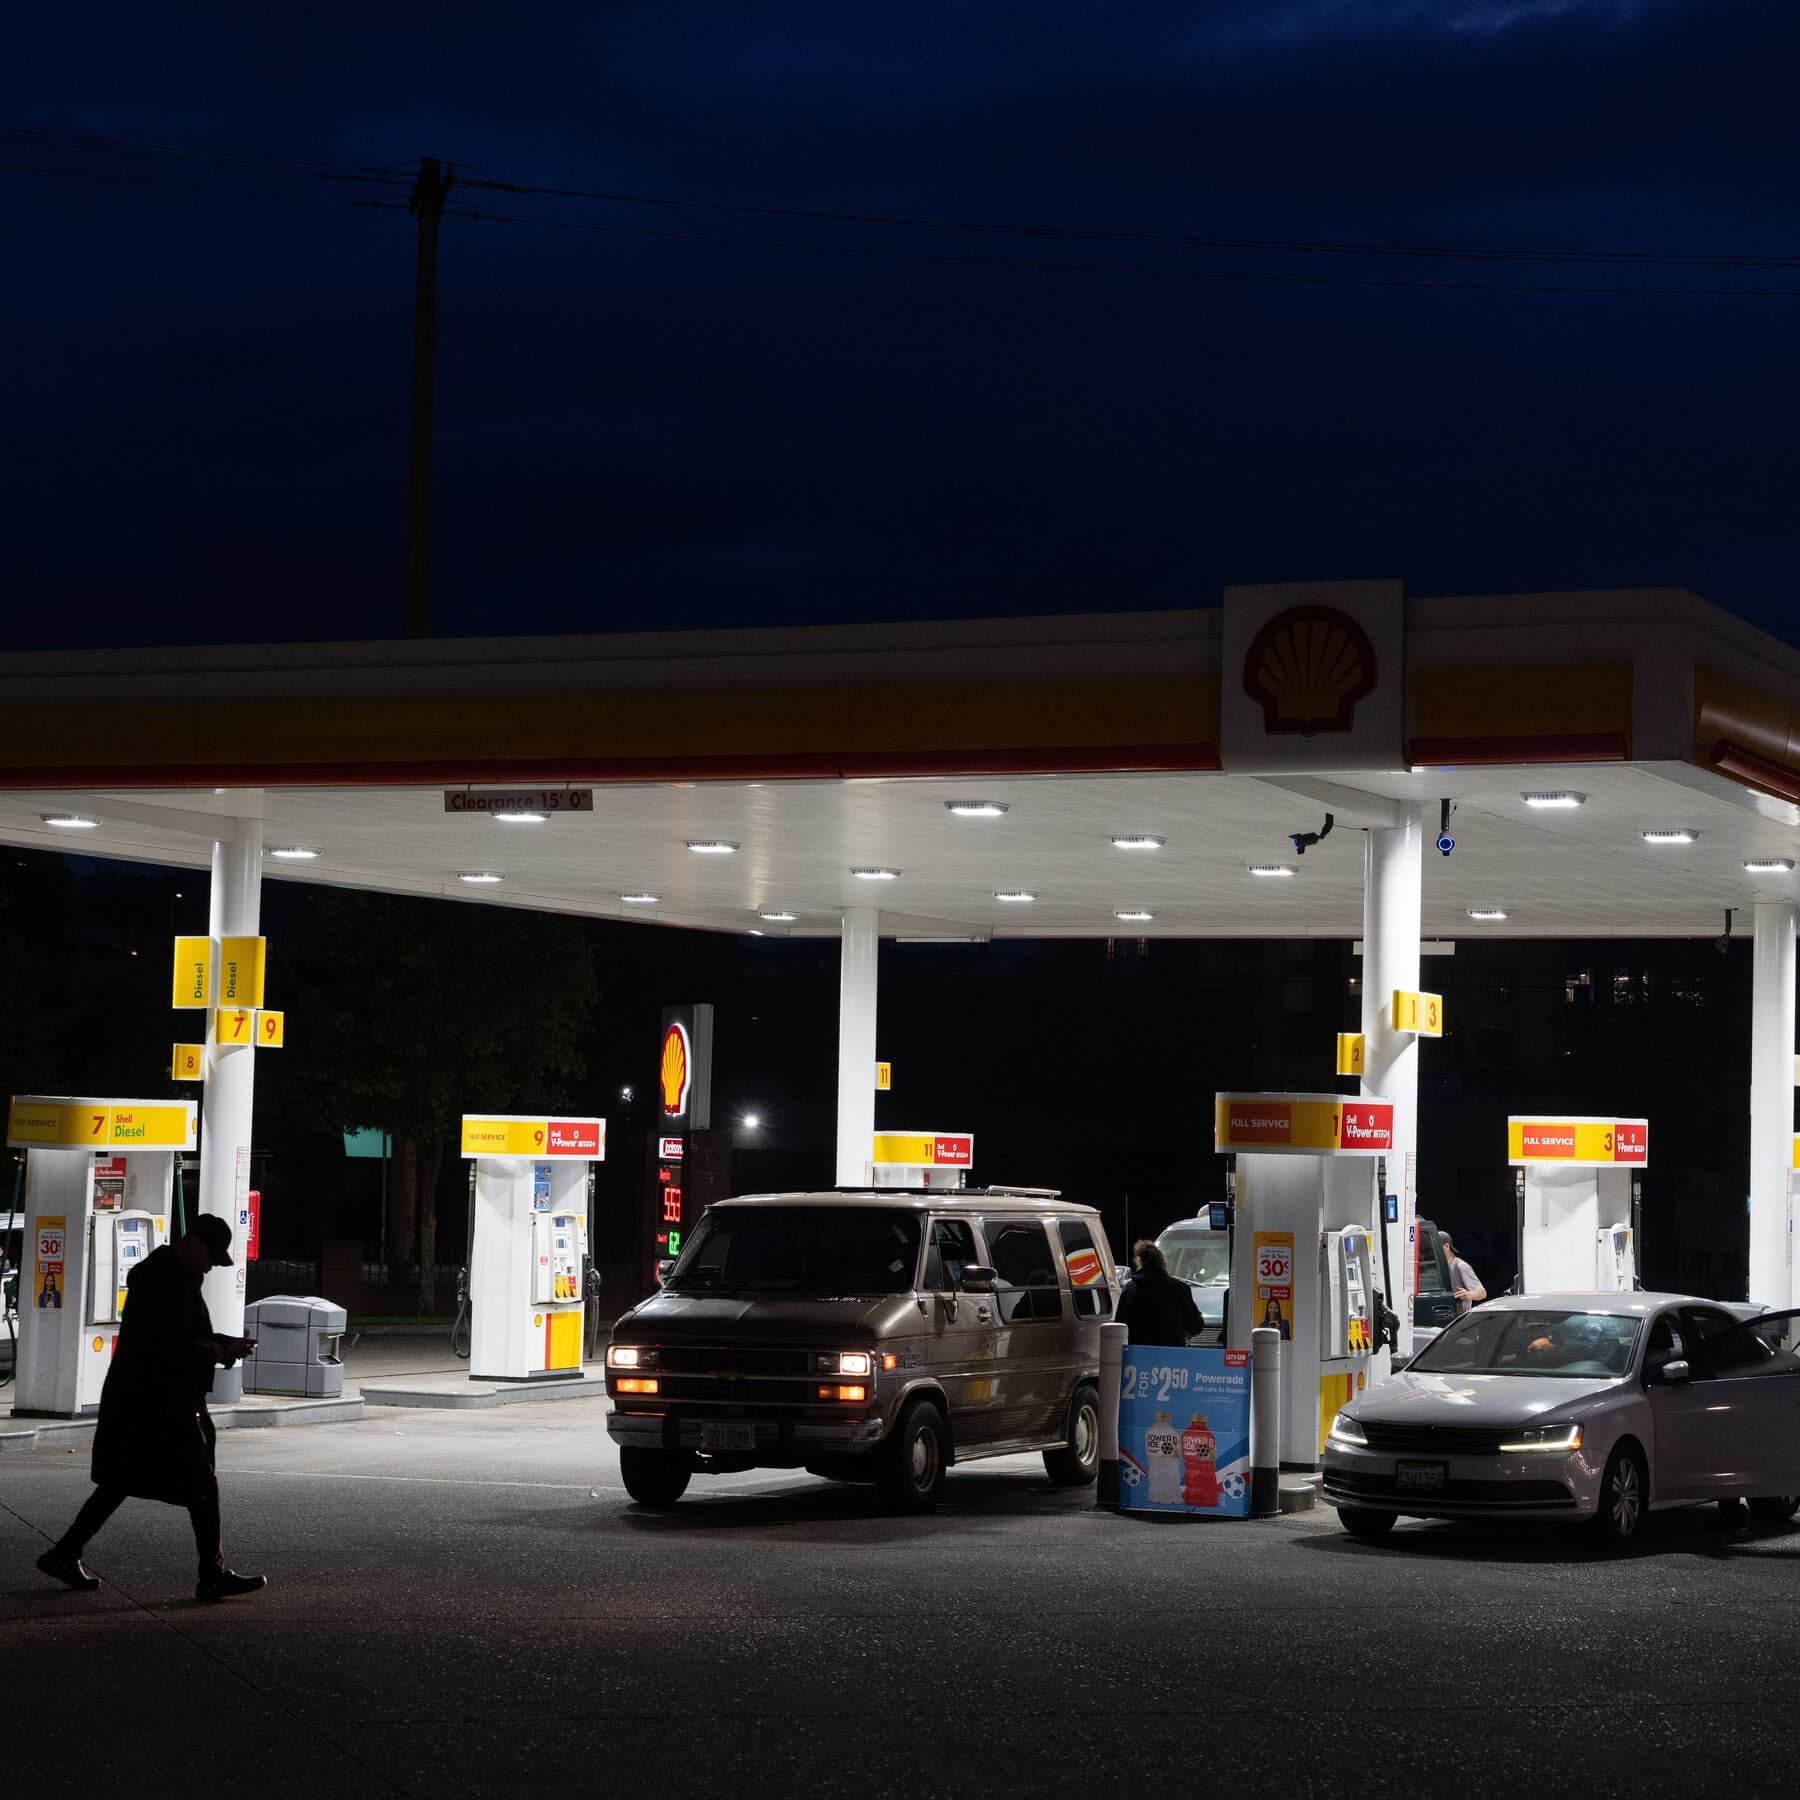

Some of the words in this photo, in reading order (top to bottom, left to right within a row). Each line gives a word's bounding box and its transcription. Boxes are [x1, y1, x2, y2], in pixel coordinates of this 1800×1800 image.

[452, 792, 533, 809] Clearance
[541, 791, 563, 808] 15'
[194, 963, 203, 998] Diesel
[227, 962, 237, 998] Diesel
[1429, 1002, 1437, 1027] 3
[233, 1017, 245, 1038] 7
[265, 1018, 276, 1039] 9
[187, 1056, 194, 1068] 8
[1353, 1048, 1360, 1062] 2
[881, 1069, 888, 1084] 11
[91, 1116, 105, 1135] 7
[116, 1115, 133, 1123] Shell
[1231, 1118, 1249, 1128] FULL
[1251, 1119, 1289, 1129] SERVICE
[1332, 1115, 1339, 1136] 1
[115, 1124, 145, 1137] Diesel
[534, 1130, 544, 1146] 9
[1346, 1125, 1372, 1138] V-Power
[551, 1138, 577, 1147] V-Power
[1523, 1137, 1540, 1145] FULL
[1541, 1138, 1574, 1146] SERVICE
[1604, 1133, 1613, 1152] 3
[924, 1144, 933, 1157] 11
[1122, 1365, 1137, 1400] 2
[1139, 1371, 1149, 1398] FOR
[1195, 1372, 1245, 1385] Powerade
